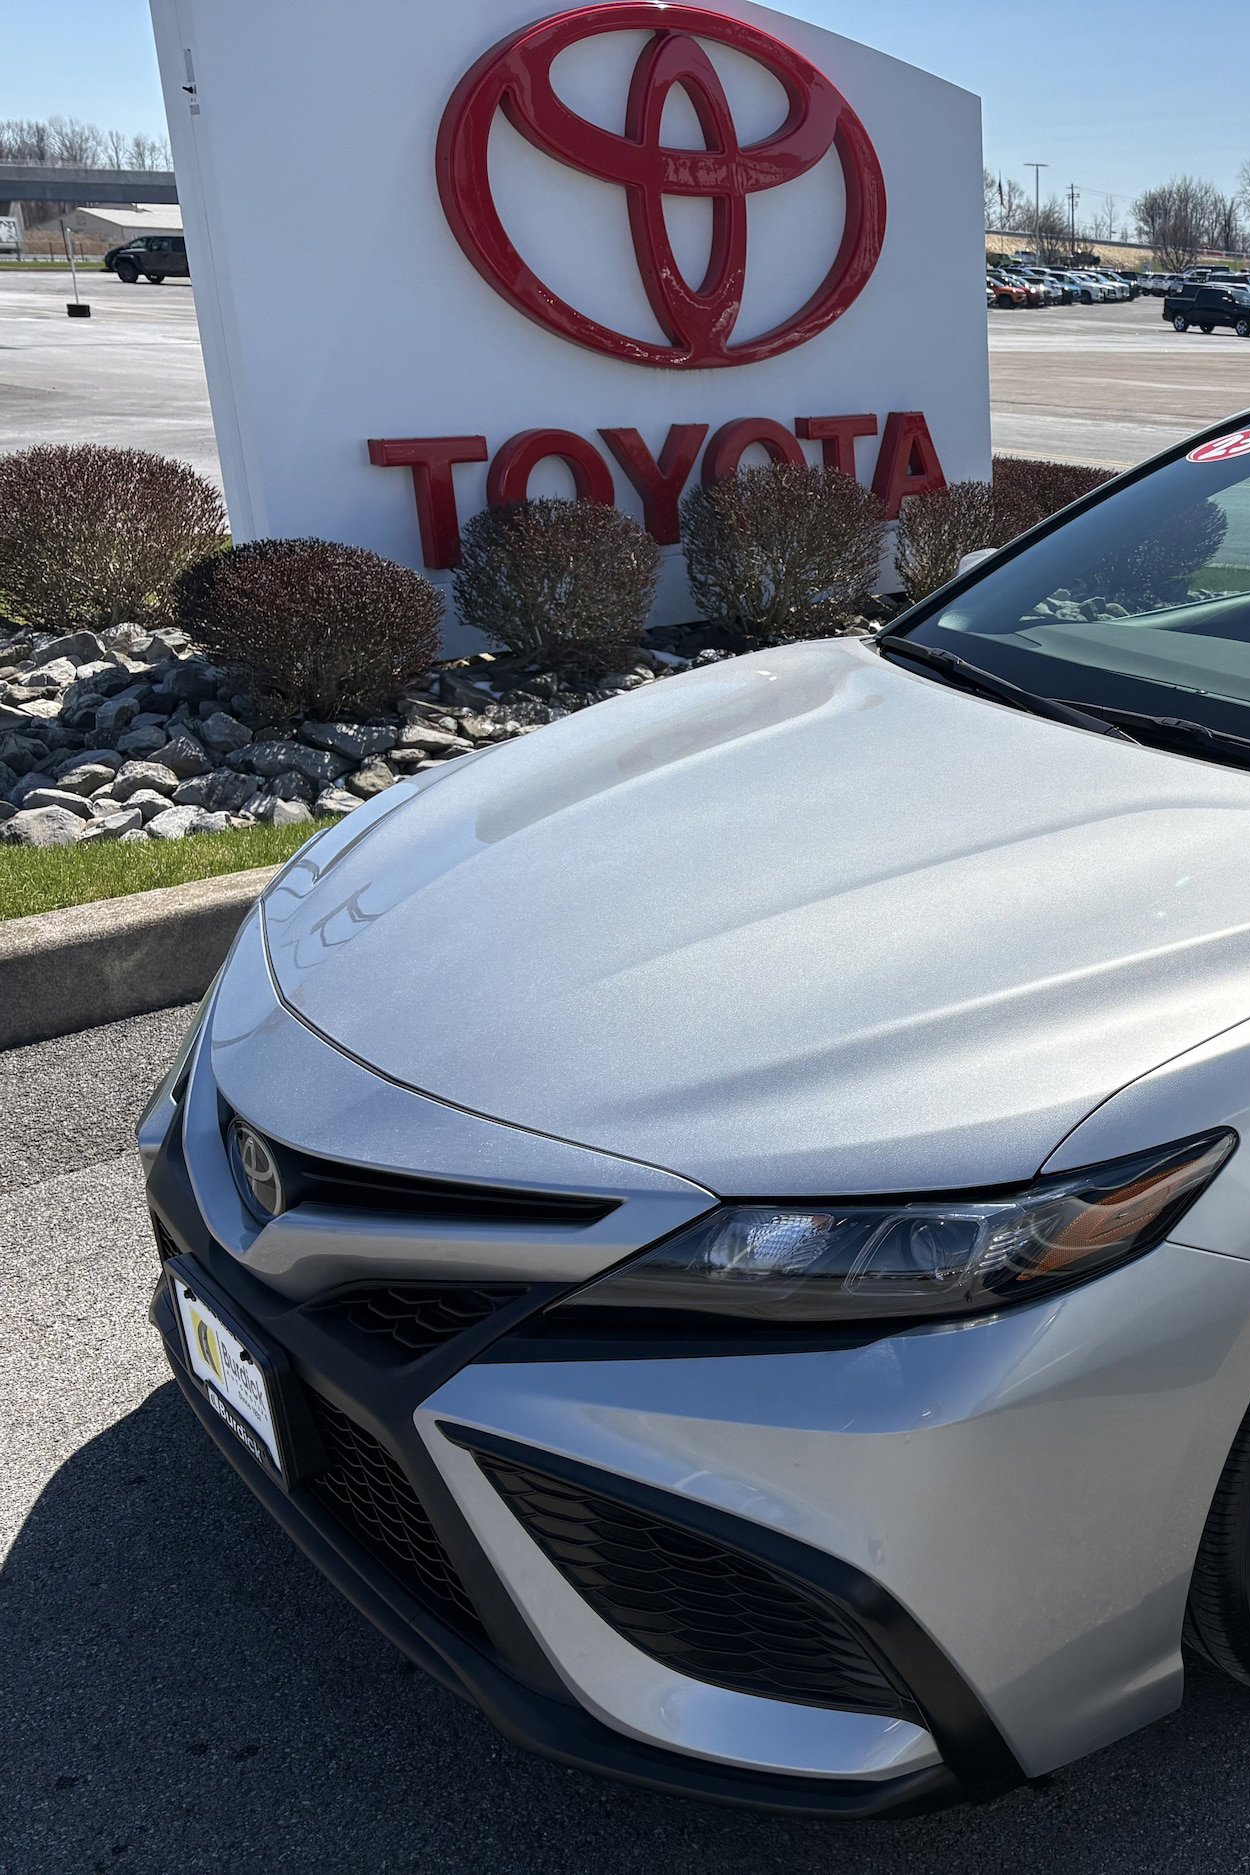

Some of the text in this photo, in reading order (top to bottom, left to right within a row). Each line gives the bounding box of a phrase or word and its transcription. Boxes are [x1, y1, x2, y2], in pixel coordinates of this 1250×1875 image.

[368, 411, 949, 569] TOYOTA
[221, 1341, 267, 1411] Burdick
[218, 1399, 263, 1463] Burdick
